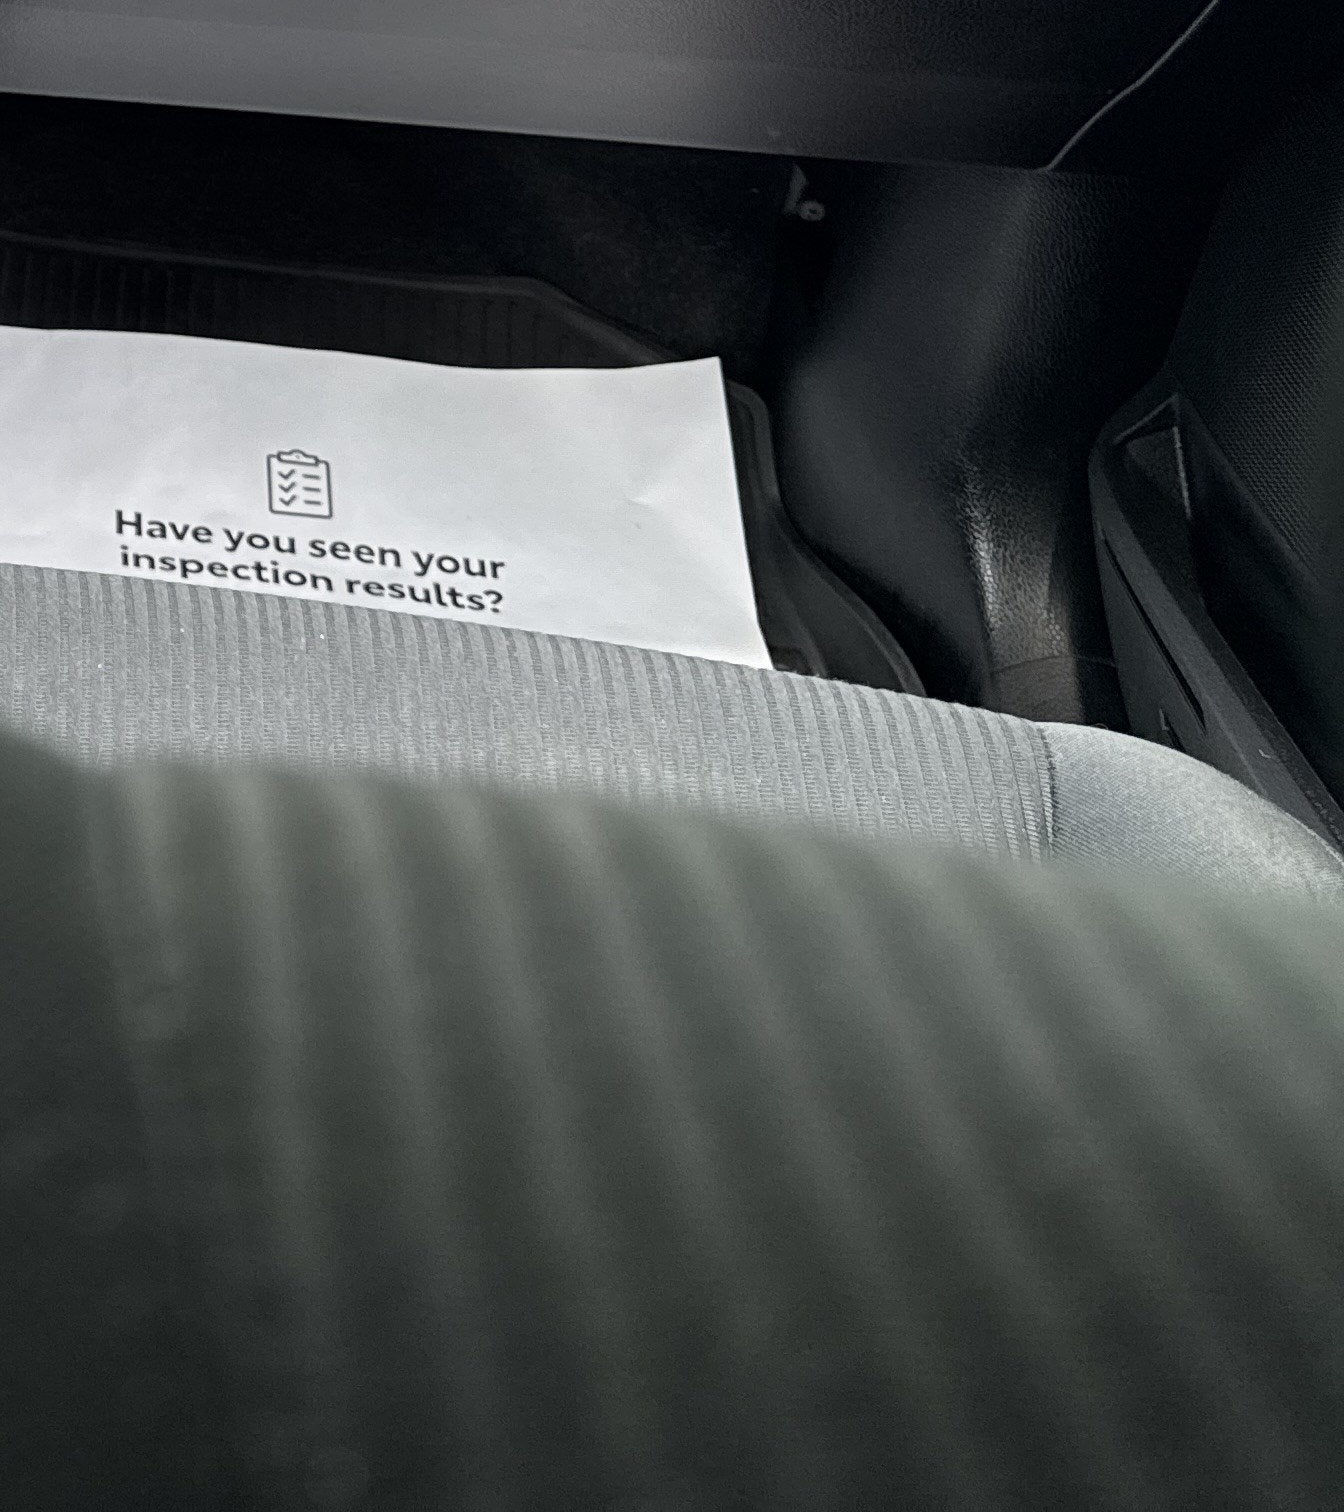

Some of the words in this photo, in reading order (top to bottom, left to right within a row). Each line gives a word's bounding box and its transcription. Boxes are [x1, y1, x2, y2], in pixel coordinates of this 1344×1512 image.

[115, 509, 213, 544] Have
[223, 526, 297, 556] you
[309, 537, 402, 569] seen
[412, 549, 506, 581] your
[119, 545, 334, 592] inspection
[345, 574, 504, 613] results?
